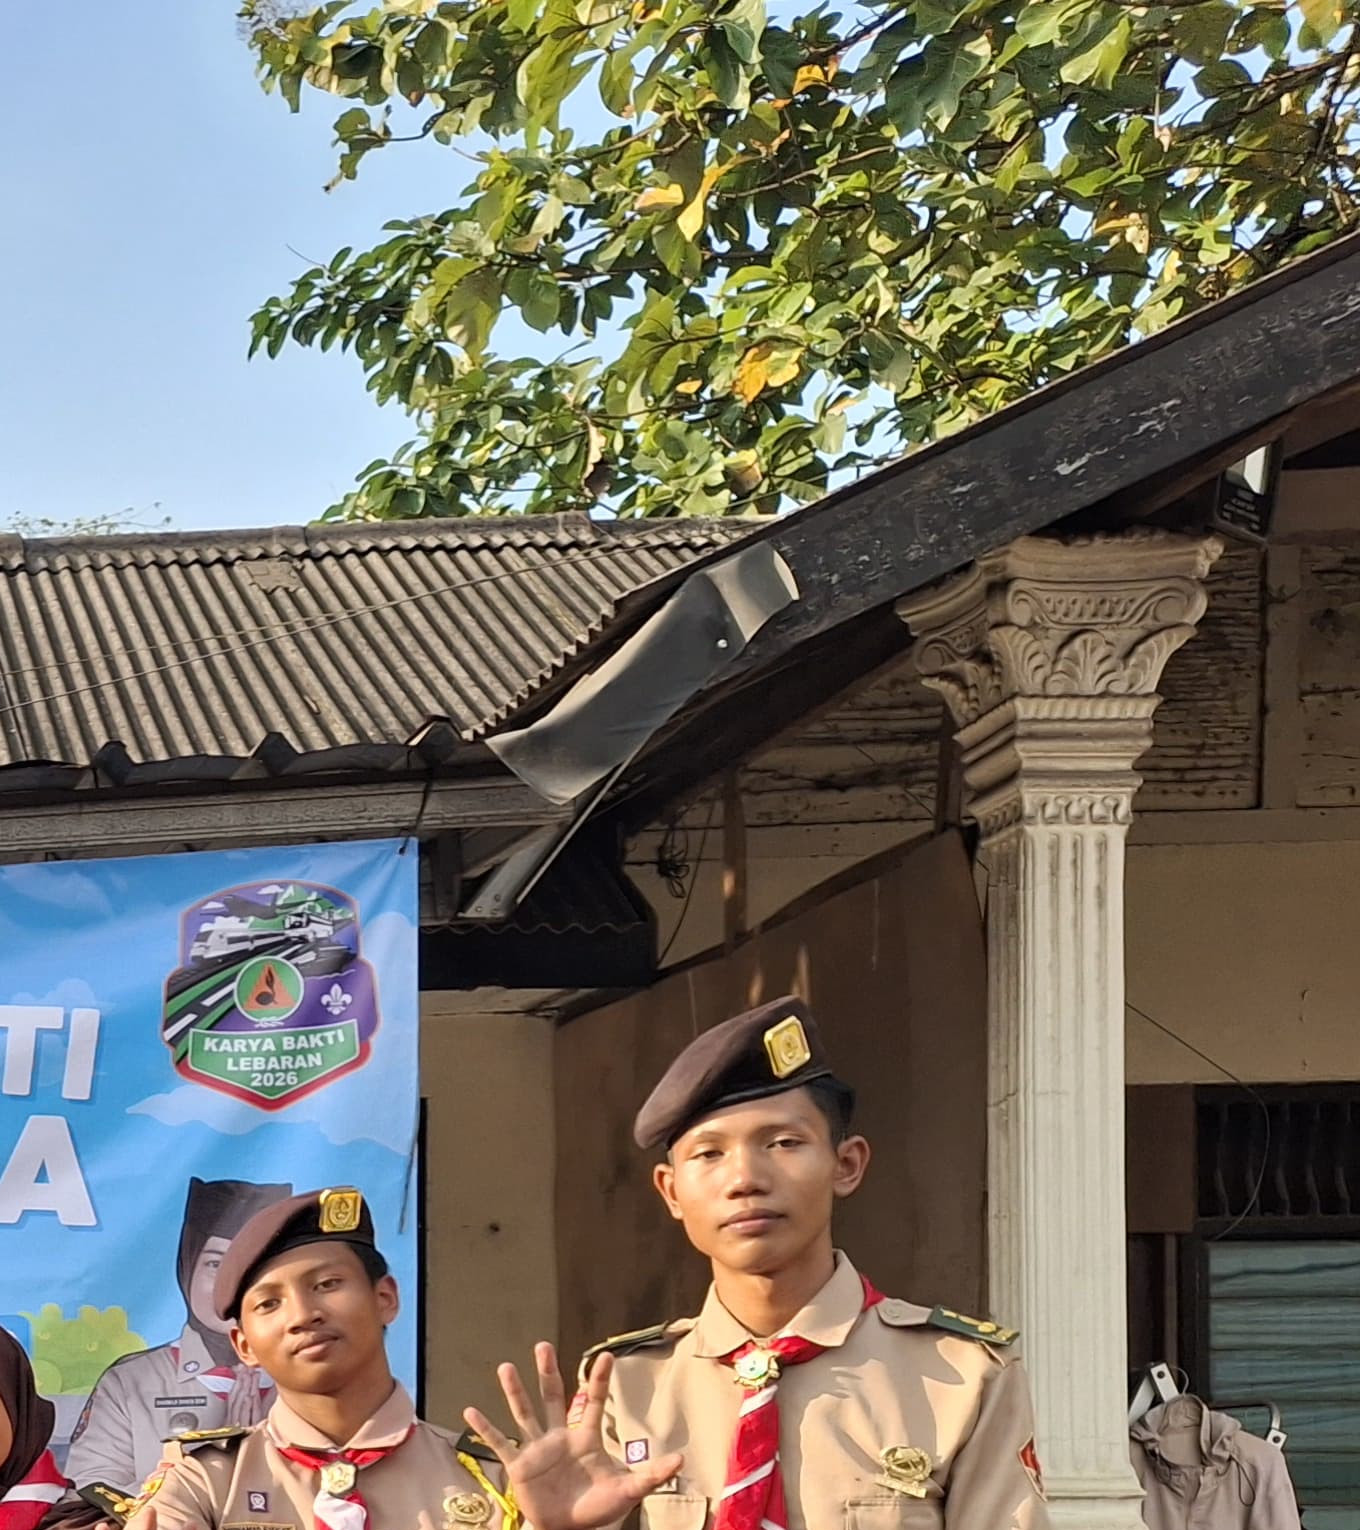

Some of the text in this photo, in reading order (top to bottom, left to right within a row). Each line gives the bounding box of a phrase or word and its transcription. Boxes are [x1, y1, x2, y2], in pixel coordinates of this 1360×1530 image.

[204, 1029, 345, 1054] KARYA BAKTI
[226, 1054, 323, 1072] LEBARAN
[250, 1071, 299, 1088] 2026
